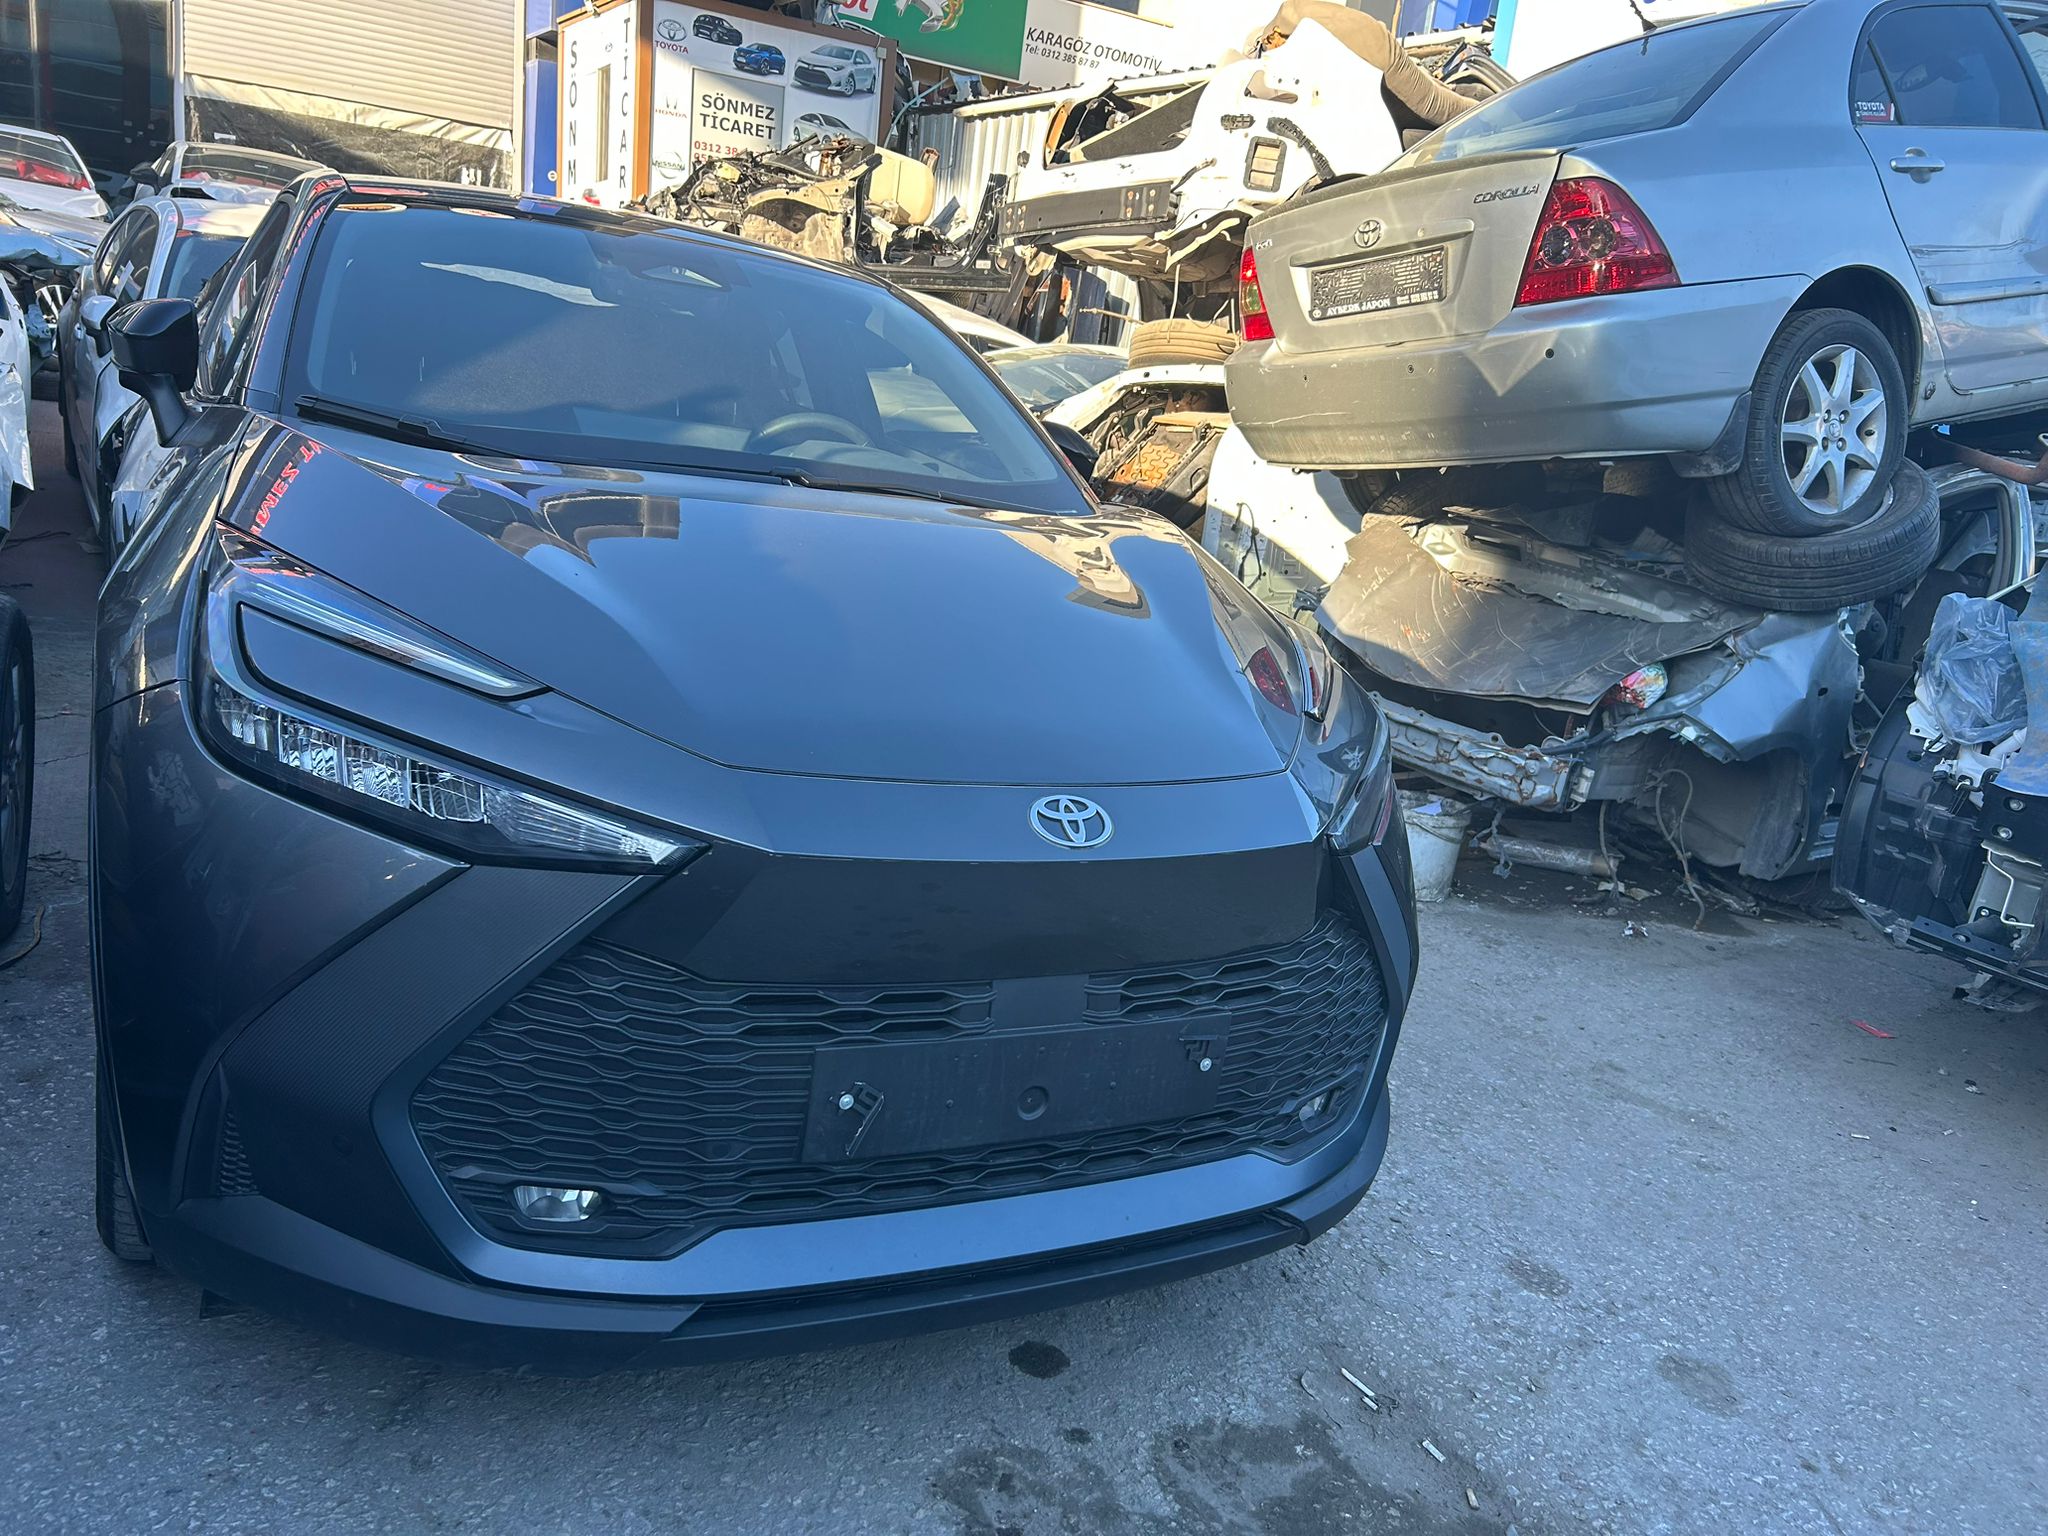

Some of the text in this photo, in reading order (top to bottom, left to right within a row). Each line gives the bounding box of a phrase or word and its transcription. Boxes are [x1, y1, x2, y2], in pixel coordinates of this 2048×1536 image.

[655, 40, 689, 54] TOYOTA
[1025, 43, 1039, 55] Tel:
[1041, 47, 1061, 61] 0312
[1062, 53, 1077, 65] 385
[1078, 56, 1089, 67] 87
[1026, 27, 1163, 71] KARAGÖZ OTOMOTİV
[655, 108, 688, 119] HONDA
[701, 92, 775, 121] SÖNMEZ
[1857, 101, 1885, 110] TOYOTA
[699, 111, 776, 140] TİCARET
[694, 140, 722, 154] 0312
[1473, 183, 1540, 204] COROLLA
